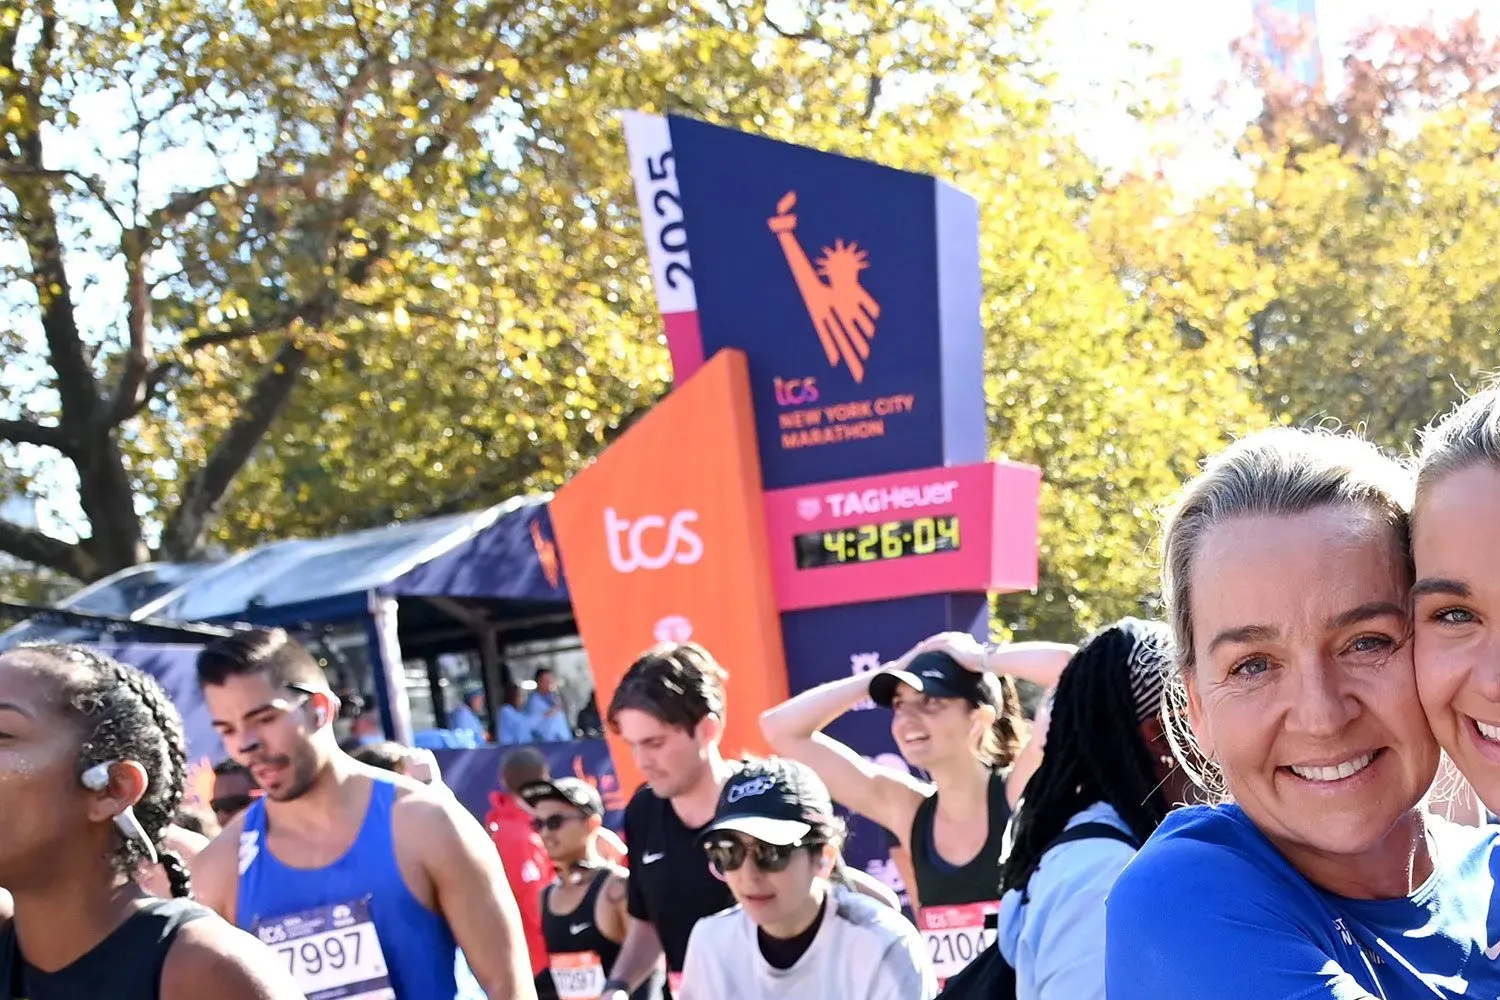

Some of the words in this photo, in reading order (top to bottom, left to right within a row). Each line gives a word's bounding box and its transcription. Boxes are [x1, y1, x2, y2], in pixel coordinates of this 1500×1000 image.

[647, 151, 692, 289] 2025
[774, 376, 819, 406] tcs
[779, 408, 822, 429] NEW
[824, 400, 873, 422] YORK
[873, 394, 915, 416] CITY
[781, 419, 885, 449] MARATHON
[604, 507, 704, 573] tcs
